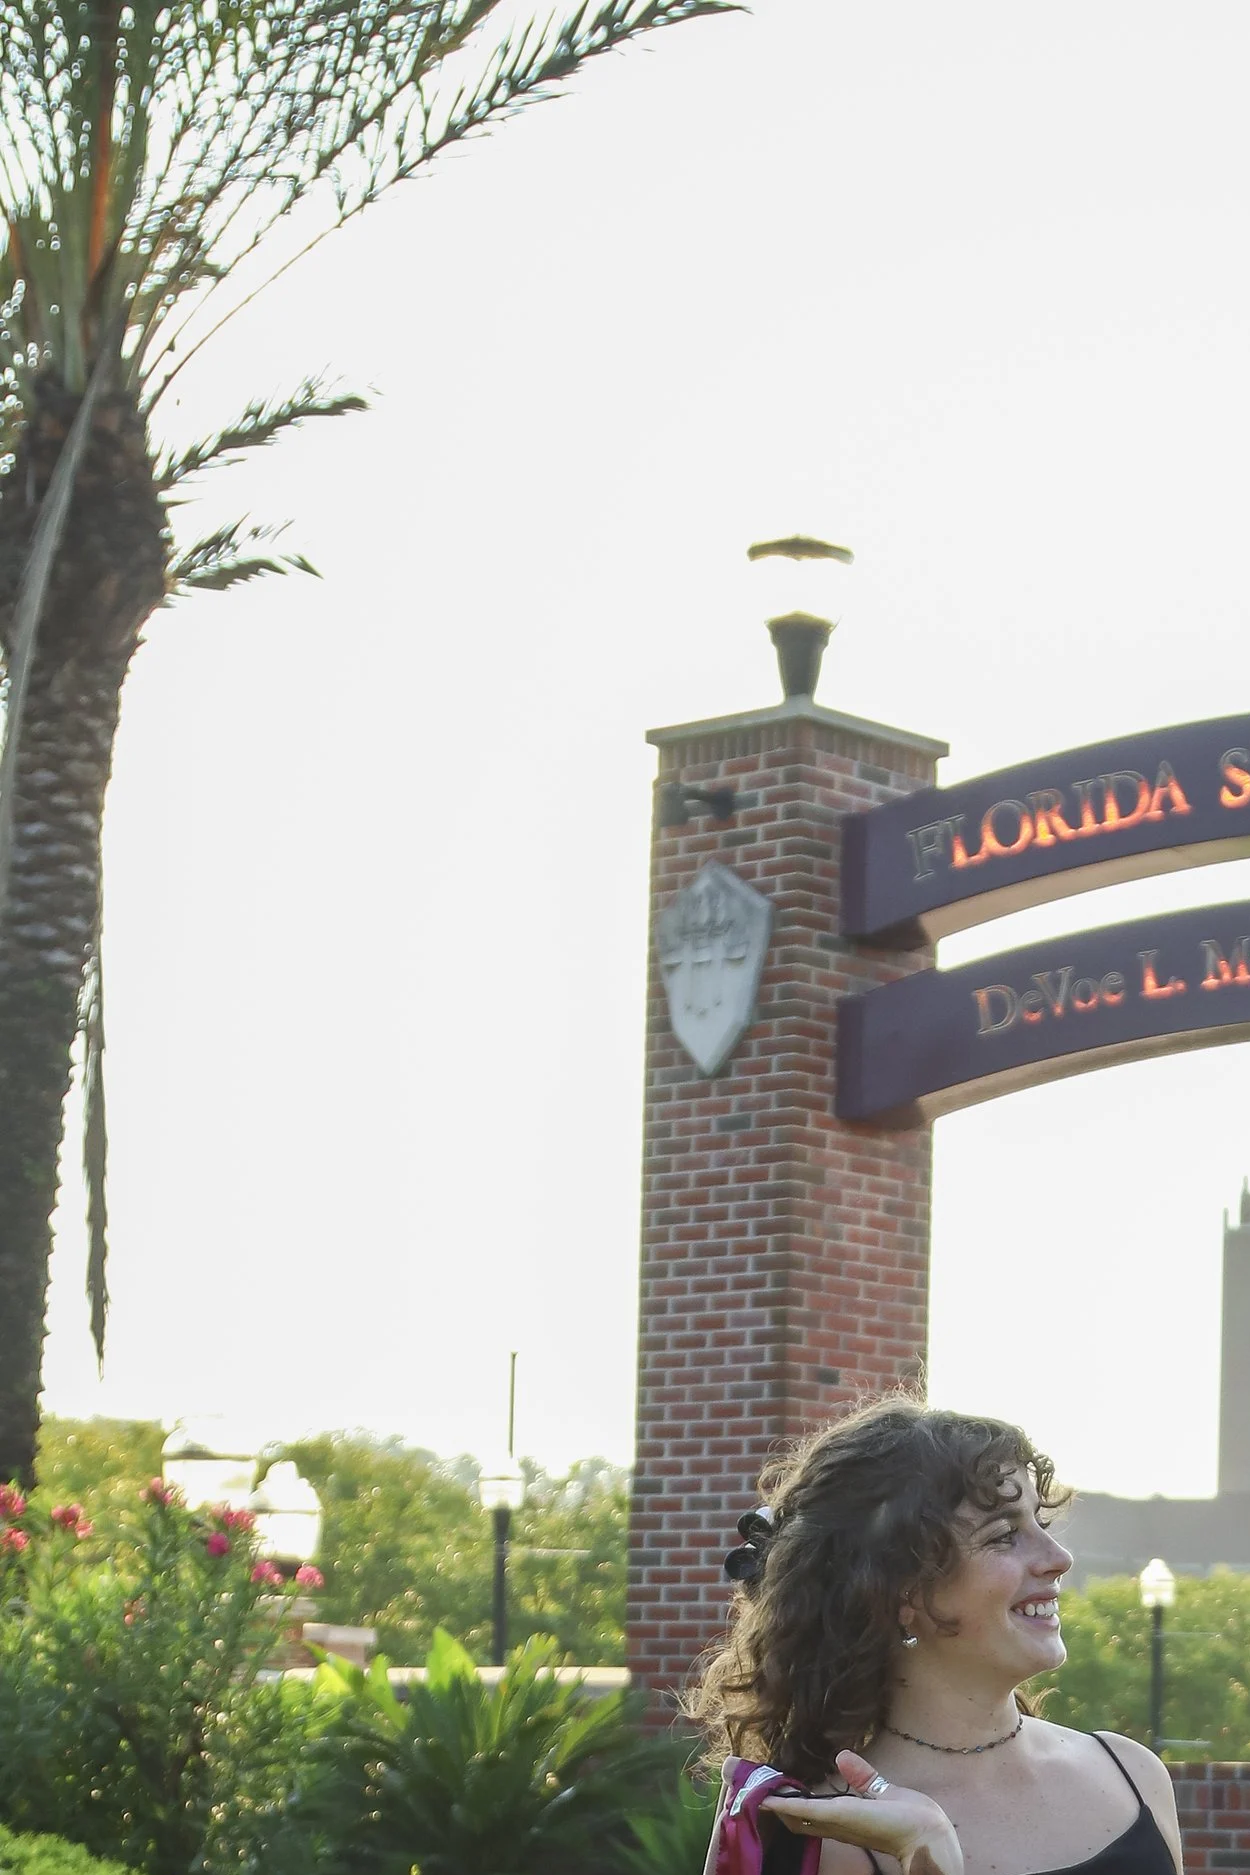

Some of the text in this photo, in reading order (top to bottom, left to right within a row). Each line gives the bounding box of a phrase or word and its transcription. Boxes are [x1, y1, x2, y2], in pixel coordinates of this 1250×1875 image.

[907, 760, 1192, 880] FLORIDA
[972, 966, 1126, 1035] DeVoe
[1138, 949, 1188, 998] L.
